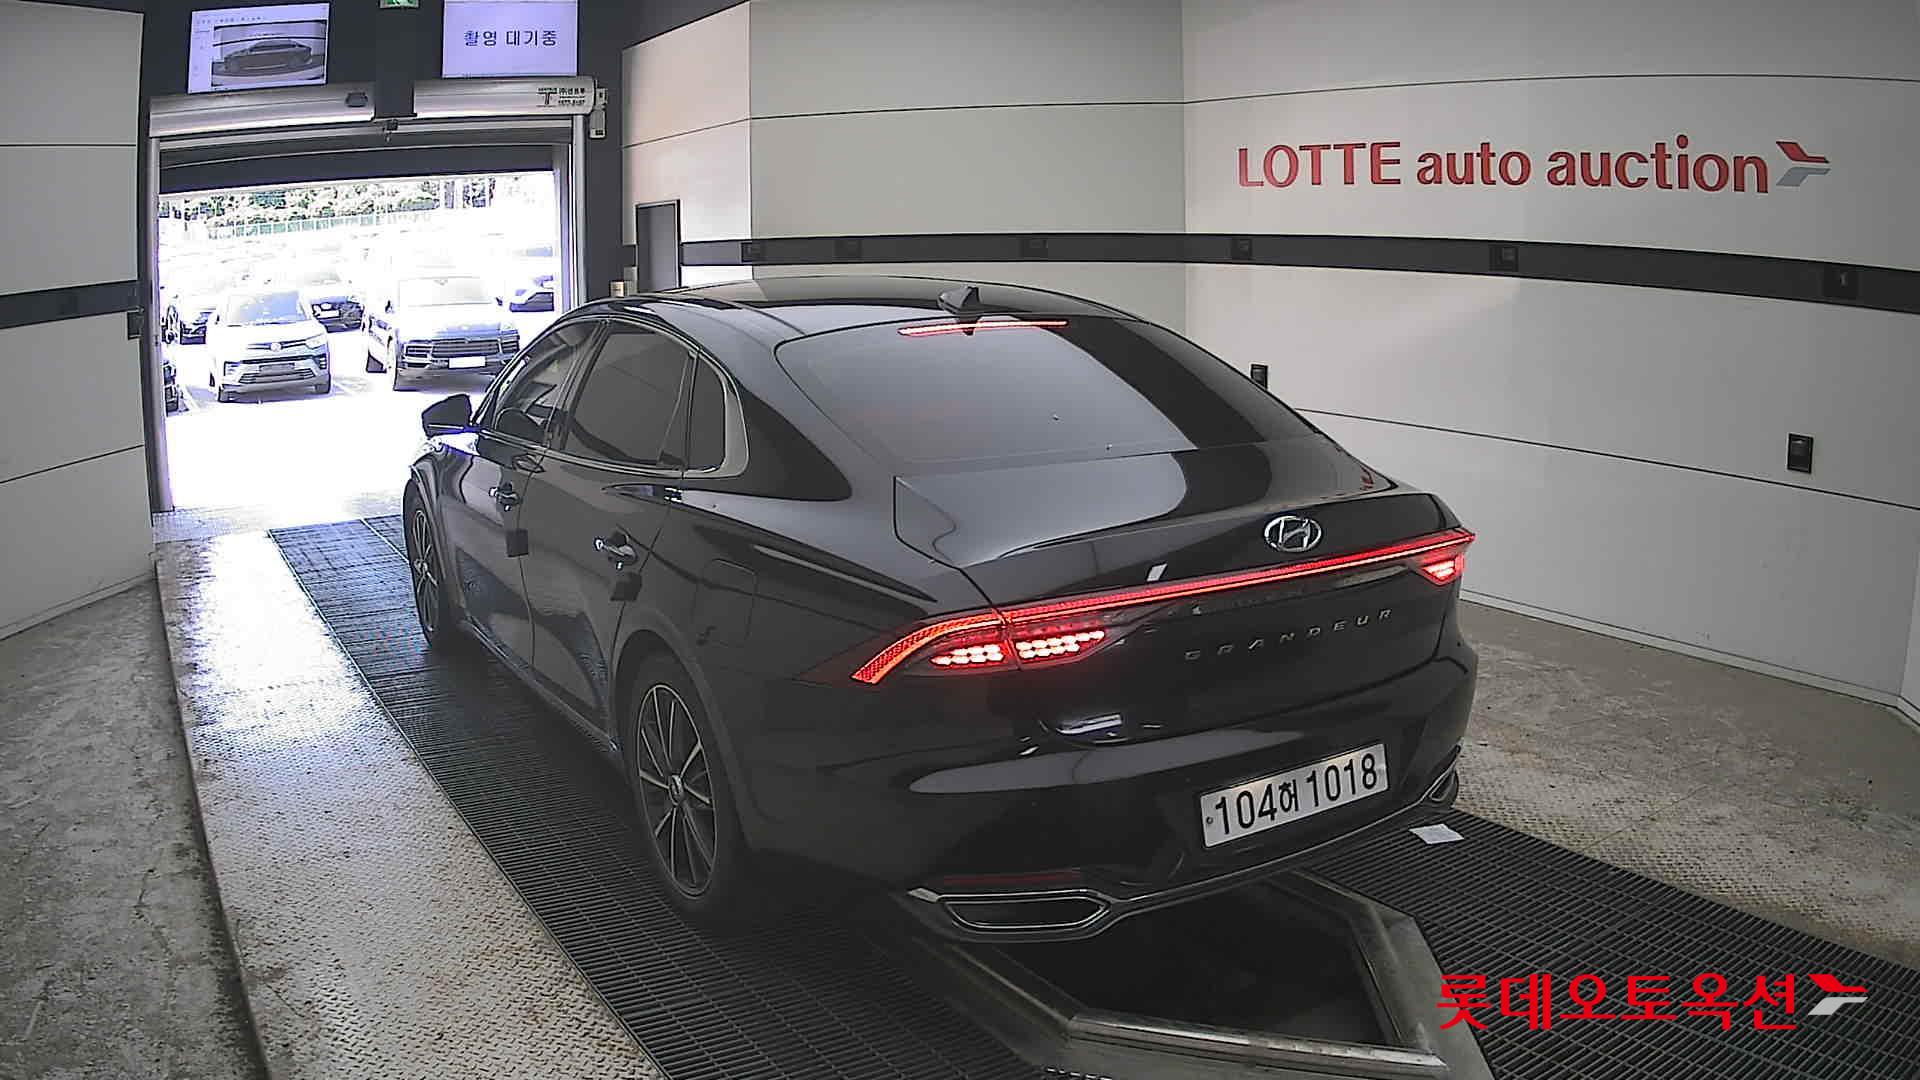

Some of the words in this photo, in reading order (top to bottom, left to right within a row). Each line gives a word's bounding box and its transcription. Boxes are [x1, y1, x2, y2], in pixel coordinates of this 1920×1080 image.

[506, 30, 557, 46] 대기중
[1239, 141, 1401, 187] LOTTE
[1417, 142, 1531, 186] auto
[1546, 135, 1769, 194] auction
[1185, 608, 1392, 660] GRANDEUR
[1215, 778, 1300, 834] 104허
[1306, 752, 1378, 808] 1018
